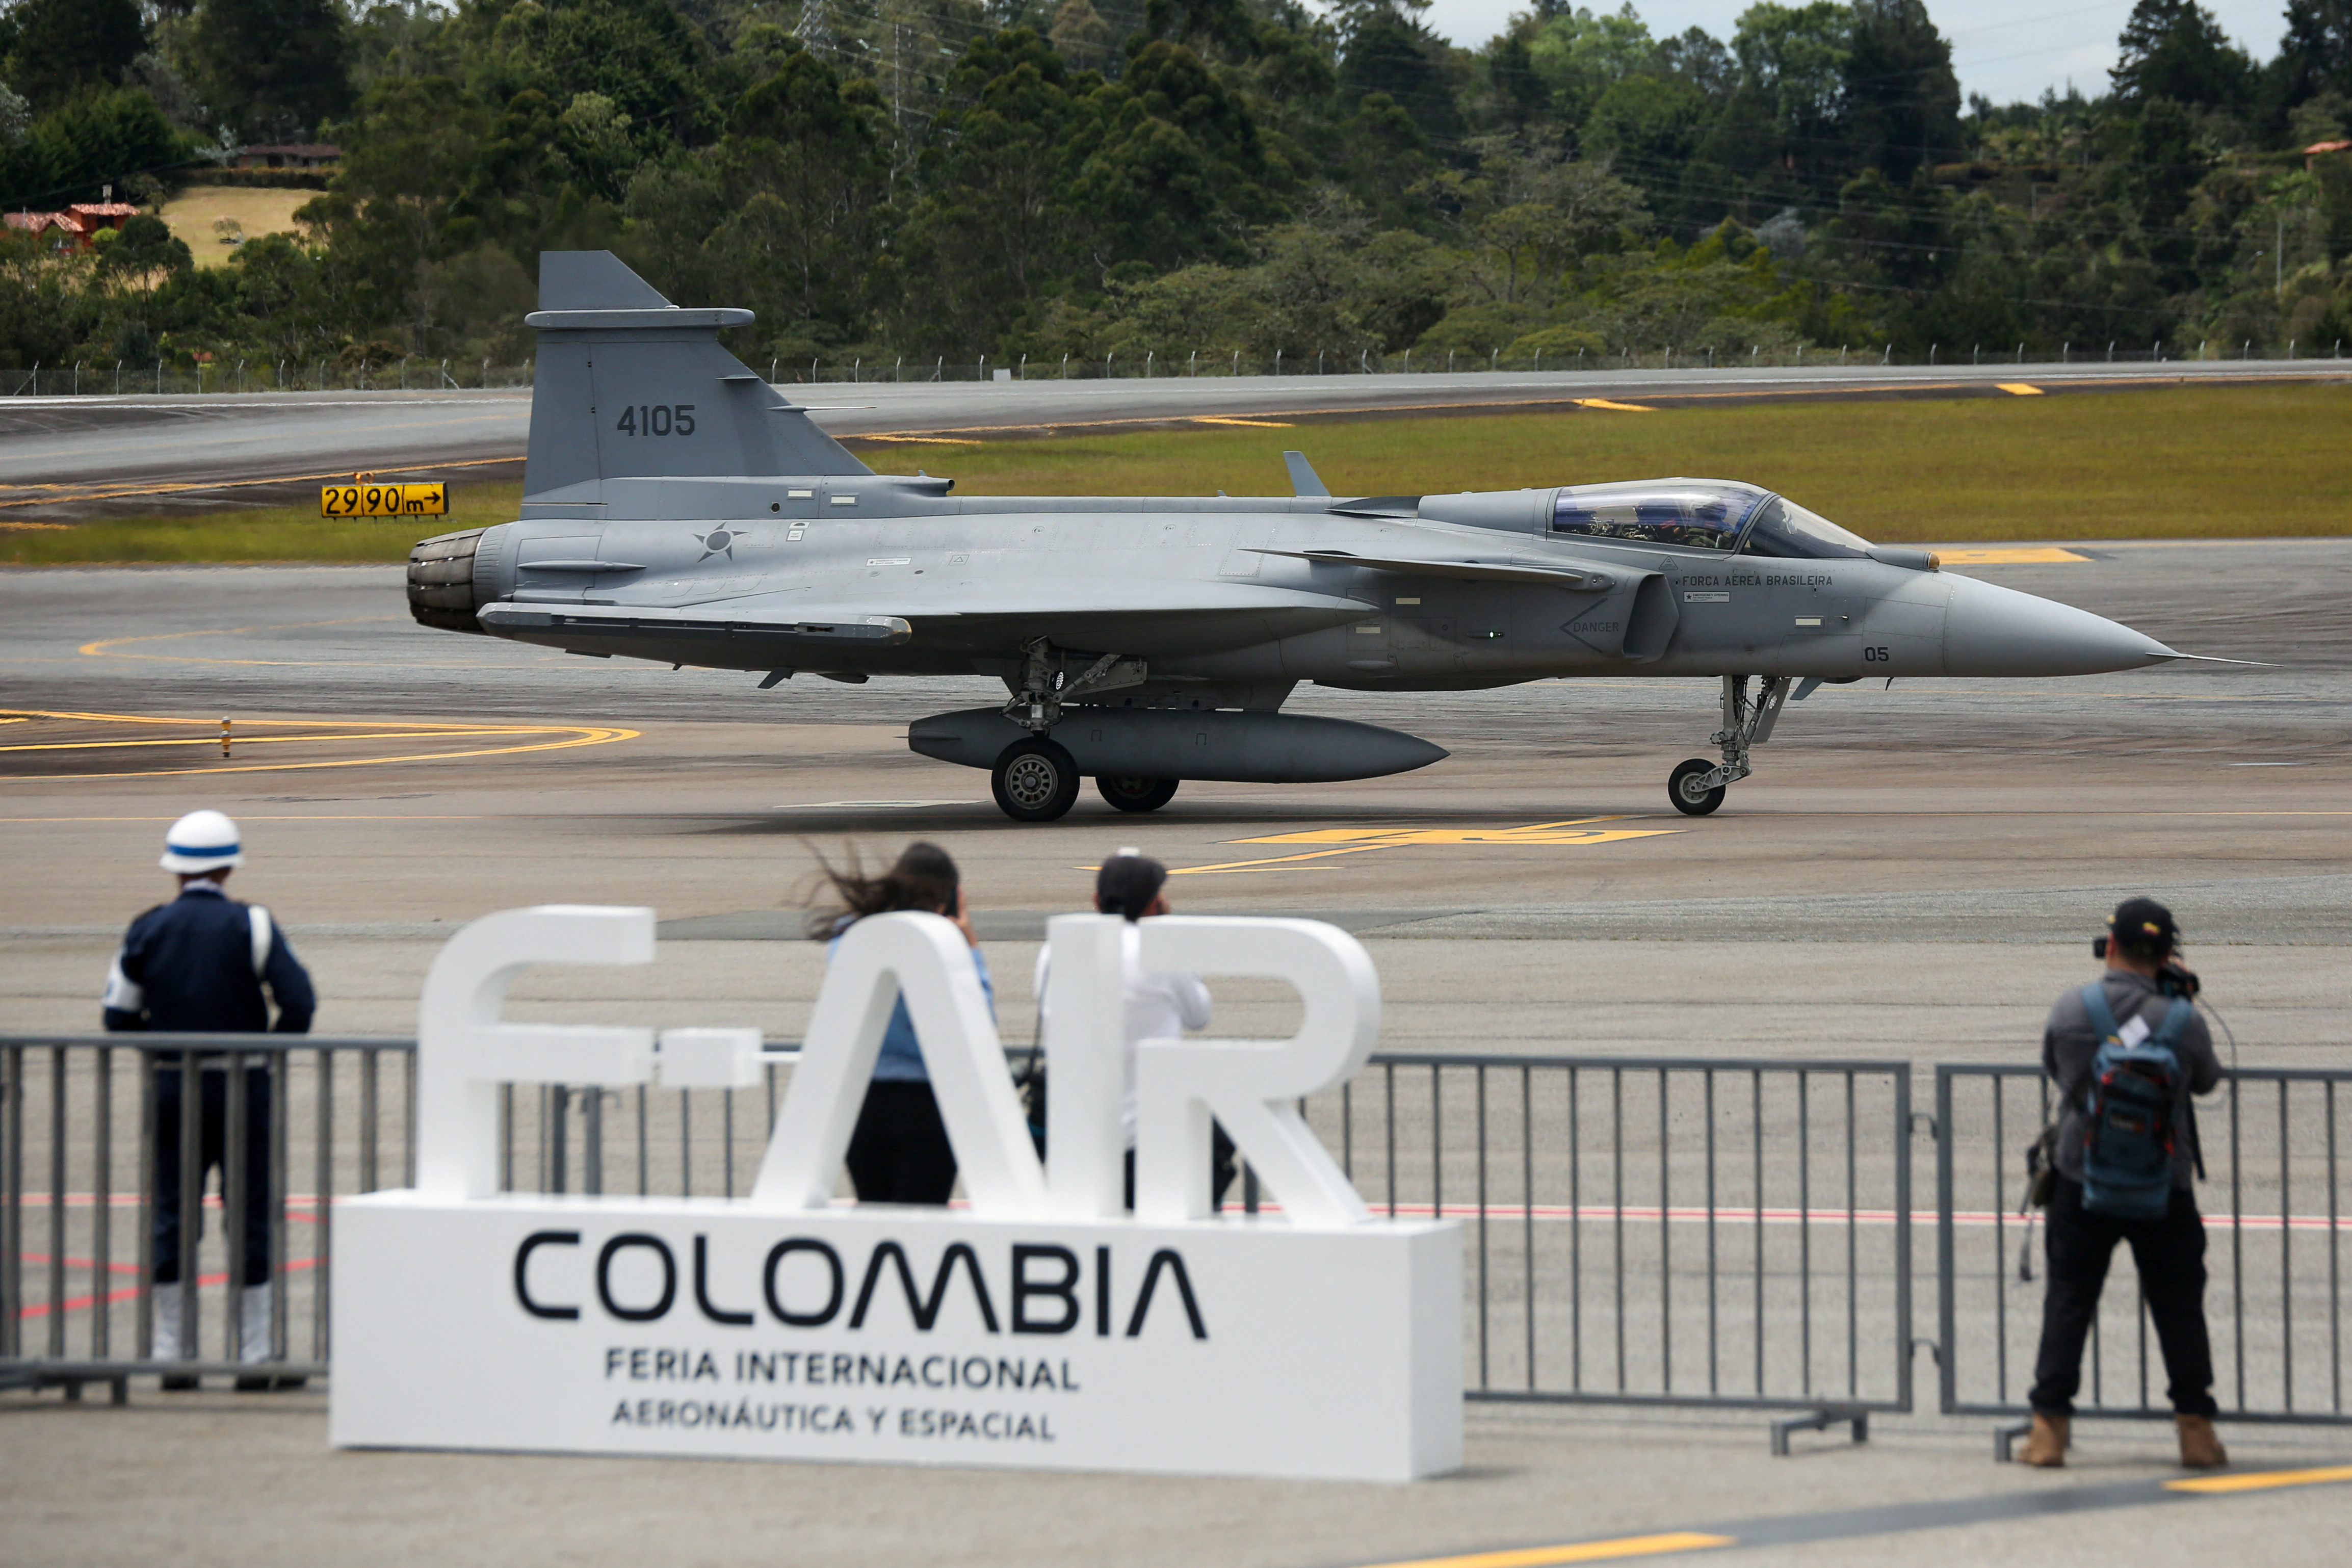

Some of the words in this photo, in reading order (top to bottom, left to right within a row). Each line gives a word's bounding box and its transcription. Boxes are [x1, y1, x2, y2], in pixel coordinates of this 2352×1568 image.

[617, 404, 695, 437] 4105
[325, 487, 400, 514] 2990
[406, 499, 424, 512] m
[1766, 575, 1833, 586] BRASILEIRA
[1573, 622, 1619, 633] DANGER
[1864, 646, 1889, 662] 05
[513, 1230, 1208, 1340] COLOMBIA
[605, 1348, 719, 1380] FERIA
[736, 1352, 1080, 1392] INTERNACIONAL
[611, 1396, 854, 1433] AERONÁUTICA
[866, 1407, 886, 1433] Y
[898, 1409, 1056, 1442] ESPACIAL
